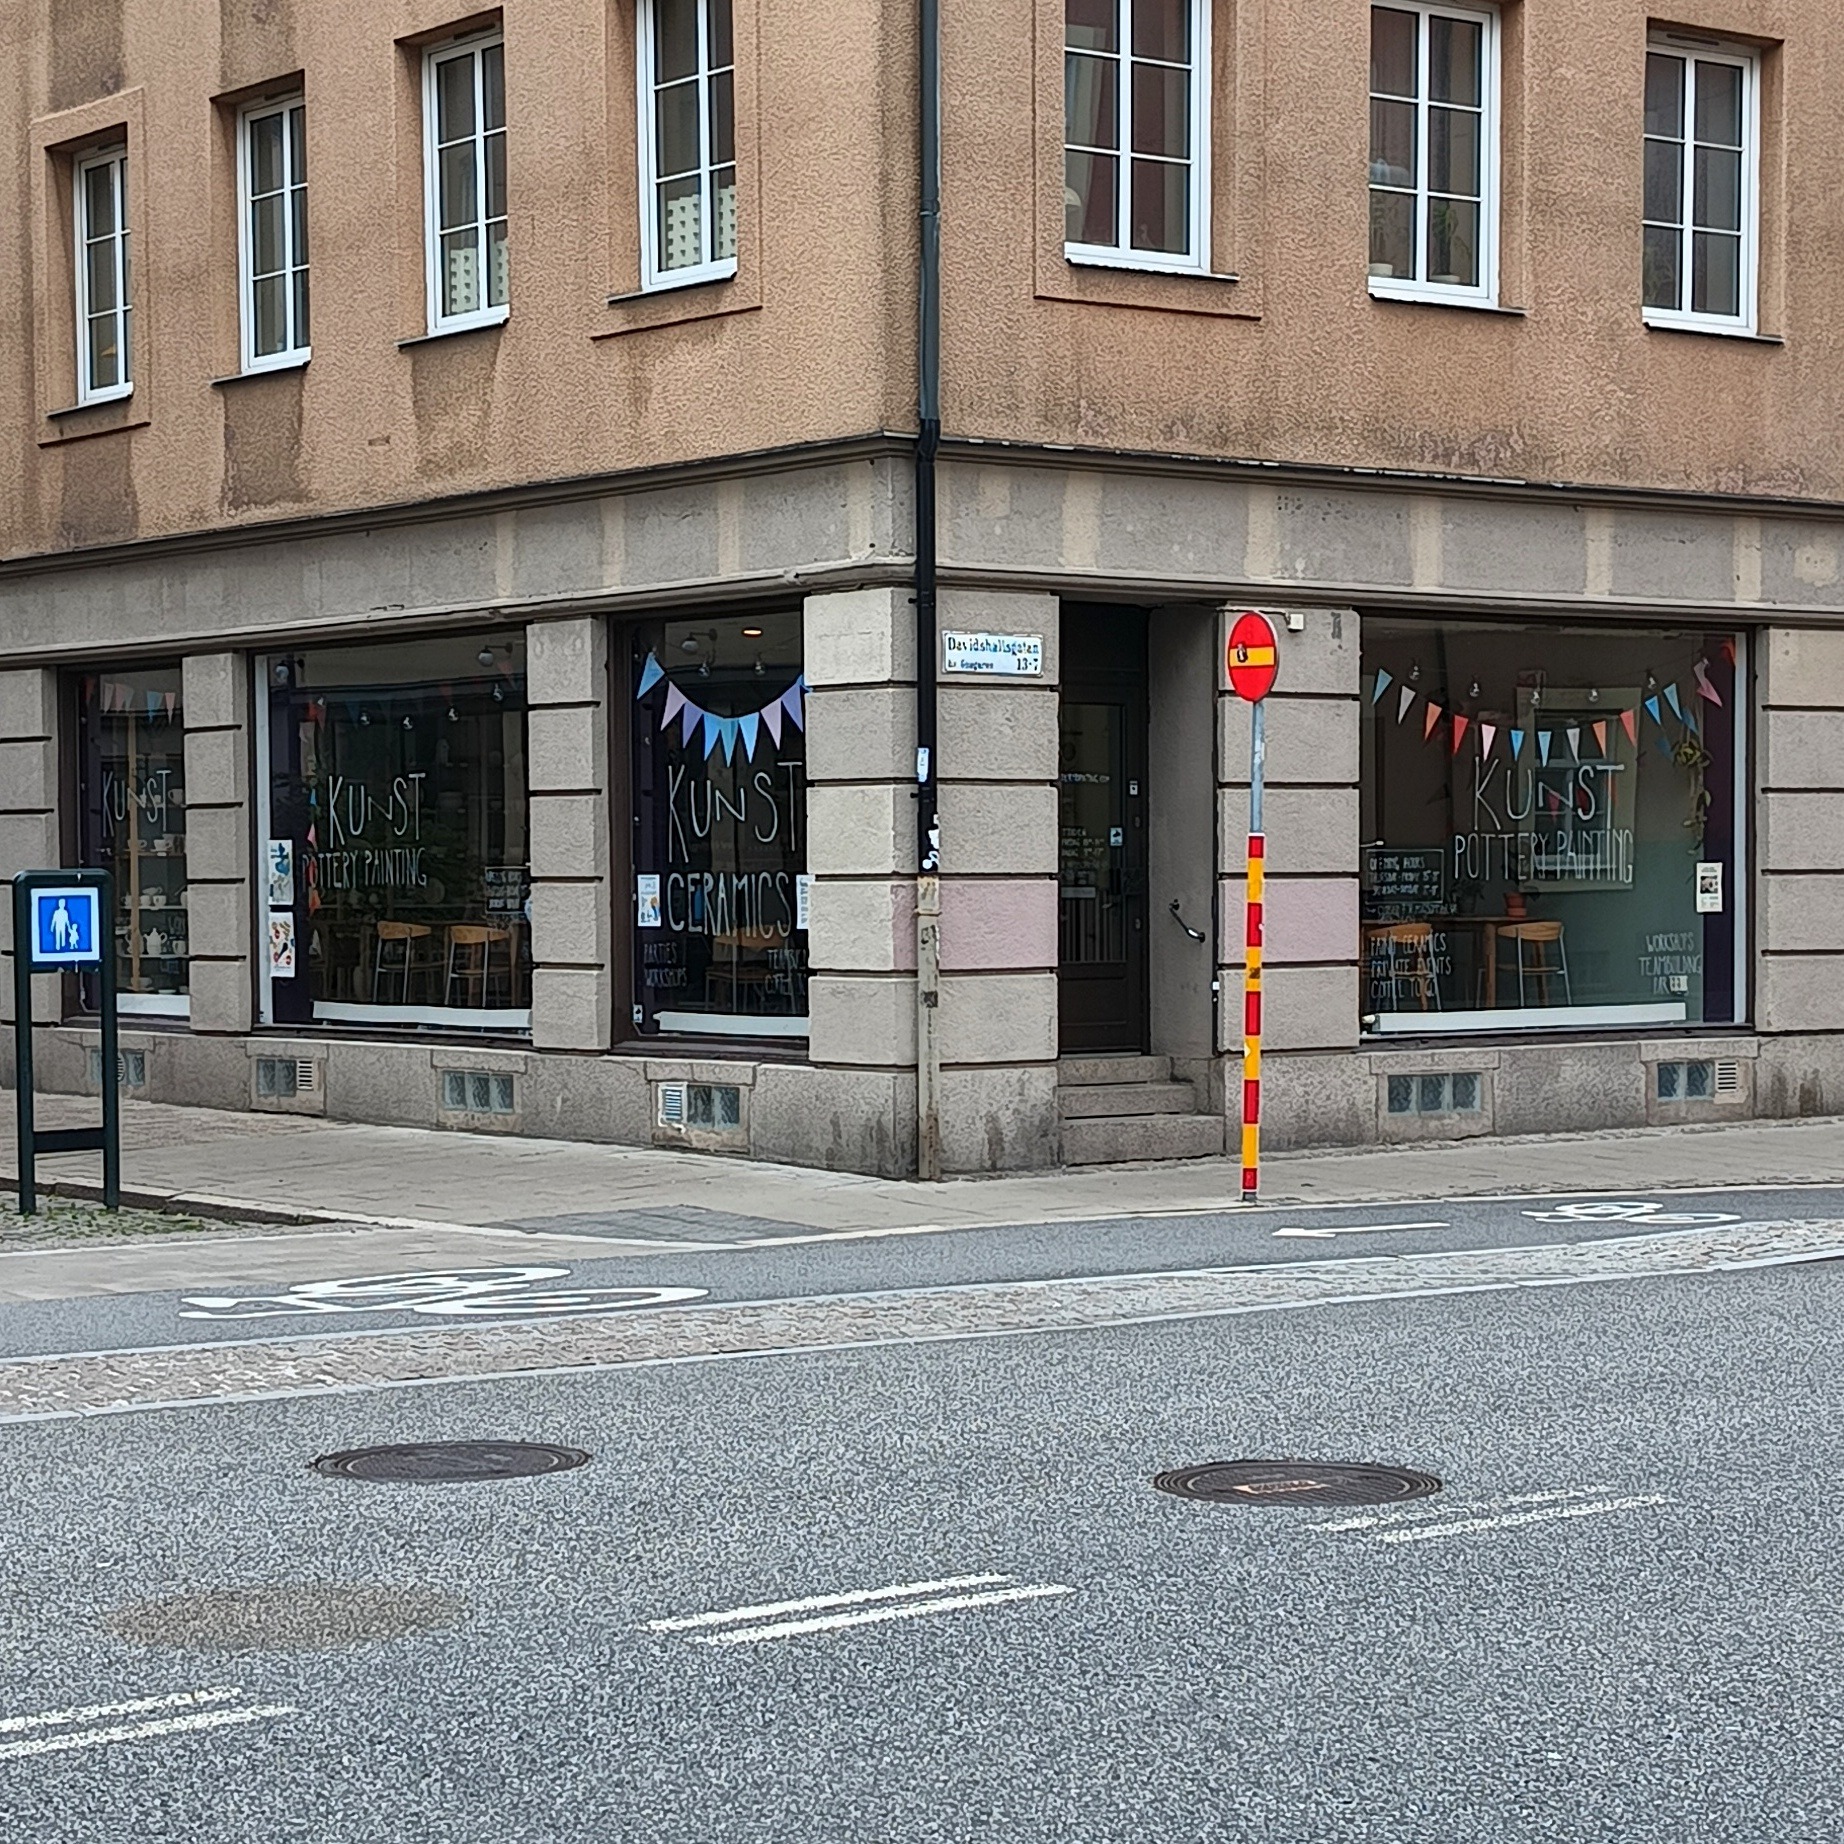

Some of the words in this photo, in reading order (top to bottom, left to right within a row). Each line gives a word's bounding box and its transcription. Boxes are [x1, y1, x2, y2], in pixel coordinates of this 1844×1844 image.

[948, 637, 1040, 656] Davidshallsgatan
[102, 769, 172, 838] KUNST
[328, 772, 426, 849] KUNST
[668, 761, 803, 863] KUNST
[1474, 756, 1626, 831] KUNST
[302, 849, 359, 892] POTTERY
[365, 847, 427, 888] PAINTING
[1455, 831, 1550, 881] POTTERY
[1557, 828, 1634, 884] PAINTING
[667, 872, 793, 939] CERAMICS
